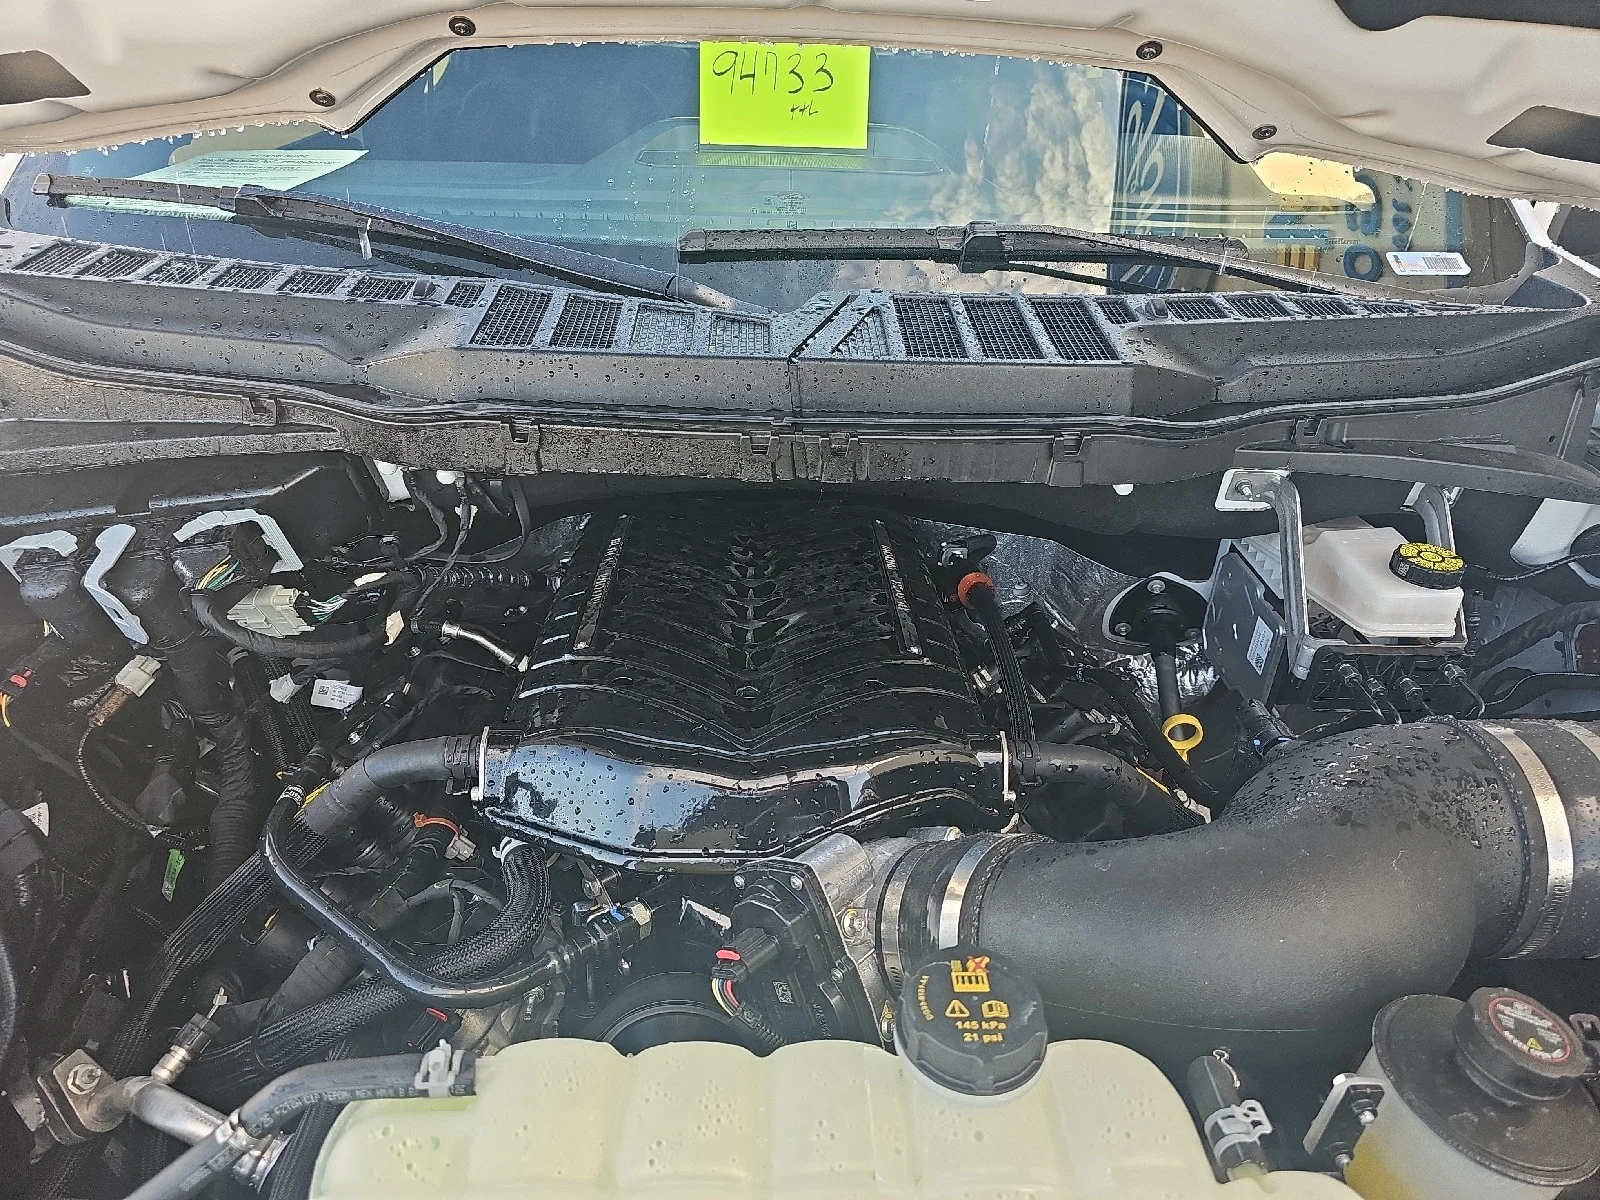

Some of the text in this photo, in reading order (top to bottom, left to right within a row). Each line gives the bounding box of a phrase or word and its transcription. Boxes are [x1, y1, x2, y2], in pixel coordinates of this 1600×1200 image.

[712, 50, 834, 95] 94733
[955, 1020, 1007, 1030] 145 kPa
[963, 1033, 1004, 1043] 21 psi
